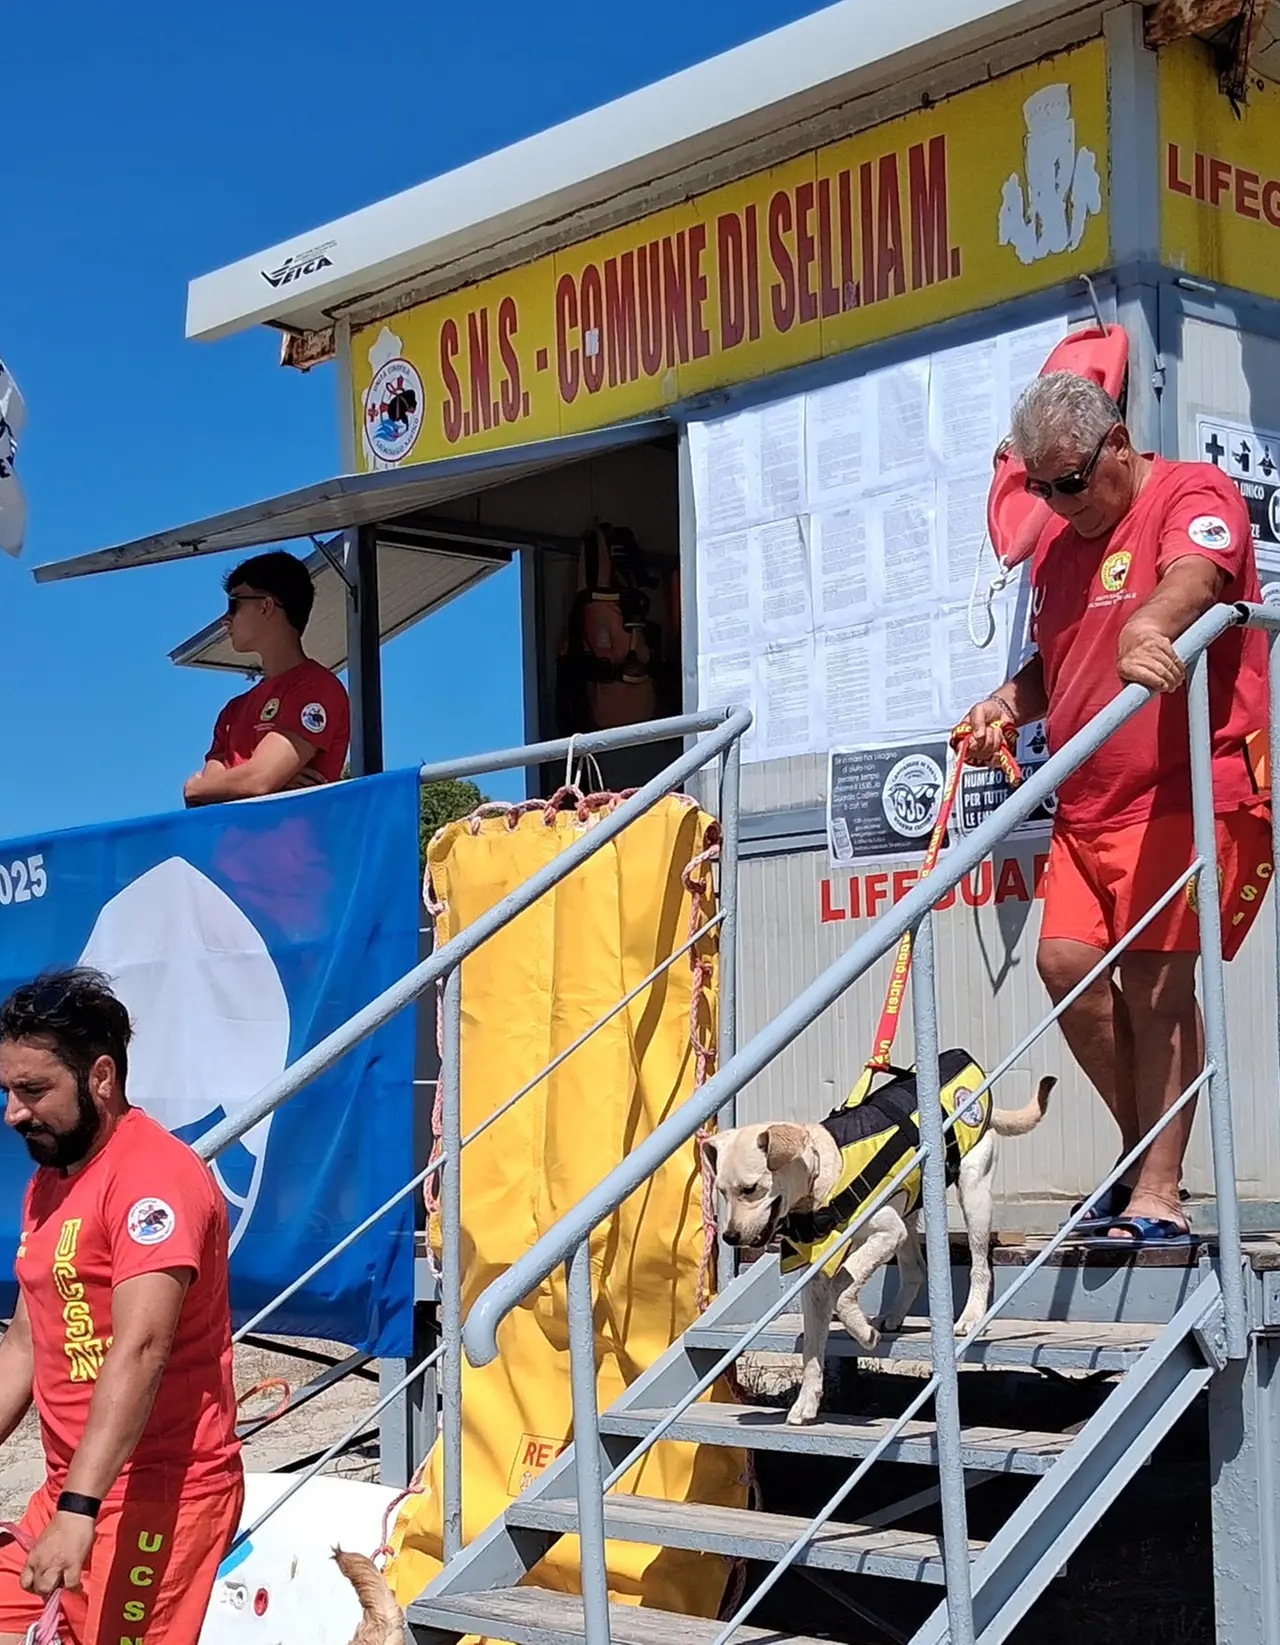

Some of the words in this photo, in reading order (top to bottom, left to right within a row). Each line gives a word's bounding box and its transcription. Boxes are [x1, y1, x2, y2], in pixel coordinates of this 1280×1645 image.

[440, 296, 530, 443] S.N.S.
[556, 222, 711, 403] COMUNE
[717, 203, 761, 351] DI
[1240, 480, 1266, 500] UNICO
[963, 792, 981, 808] PER
[53, 1218, 105, 1383] UCSN
